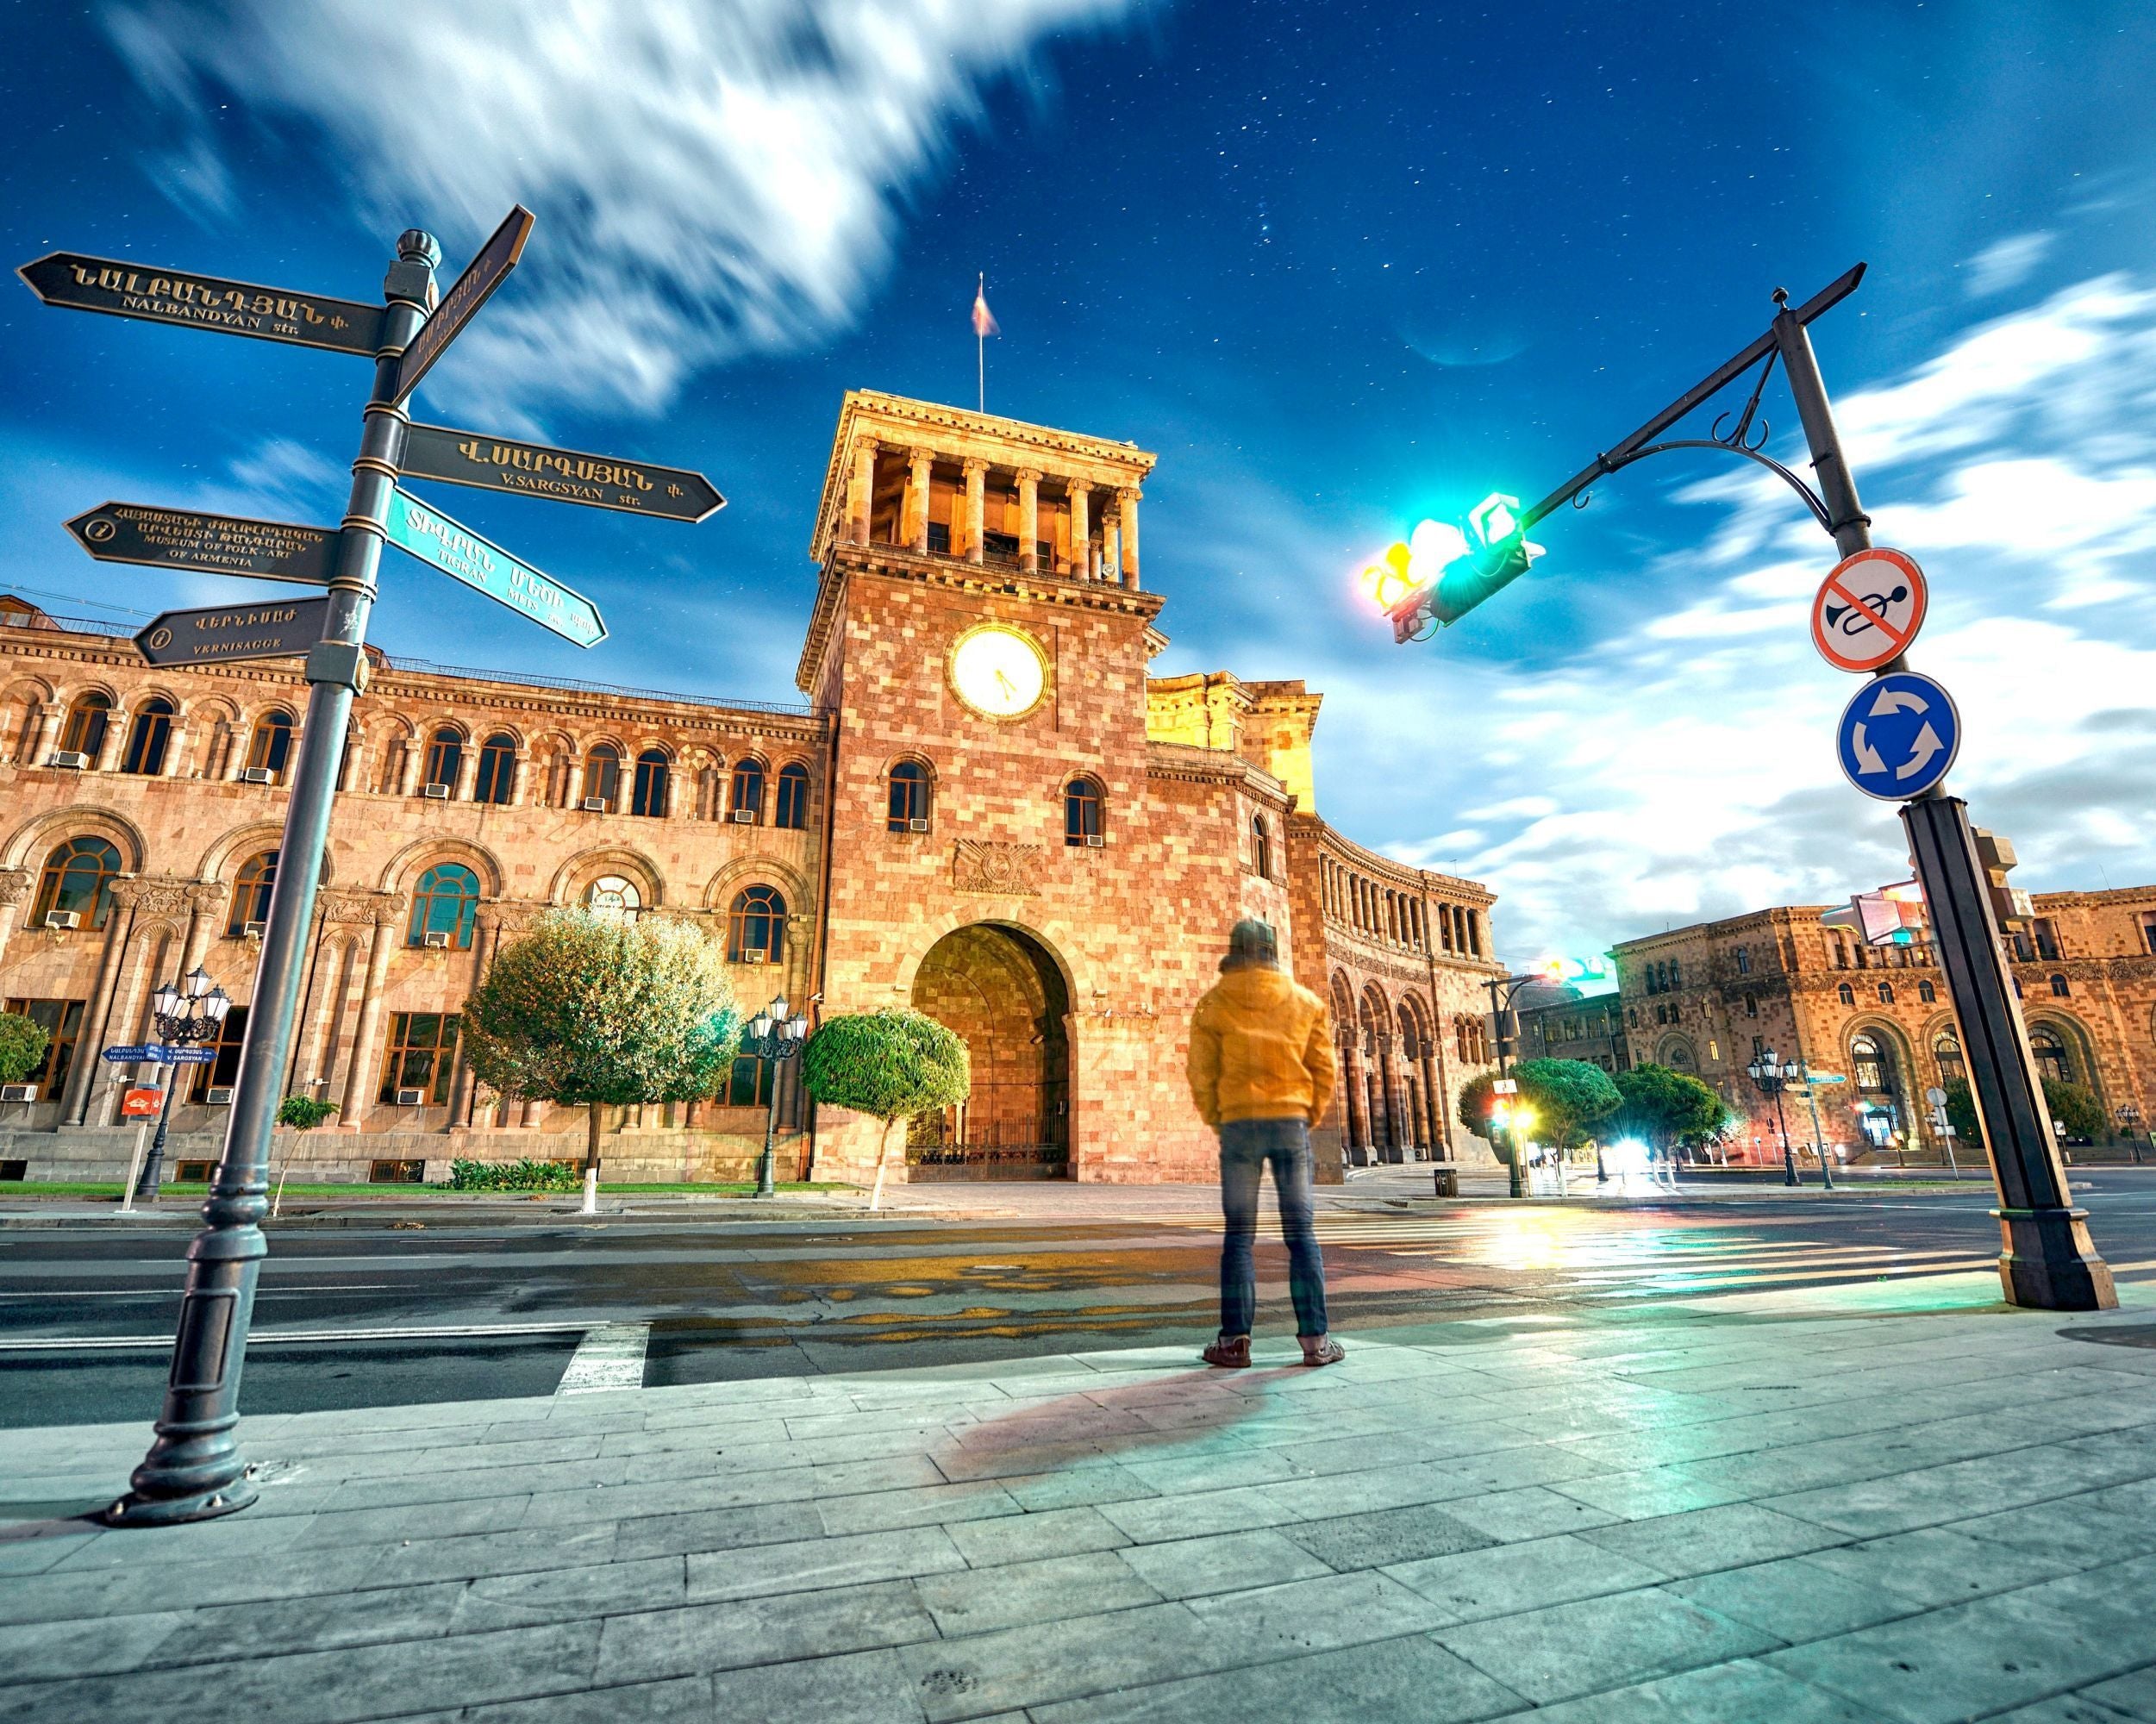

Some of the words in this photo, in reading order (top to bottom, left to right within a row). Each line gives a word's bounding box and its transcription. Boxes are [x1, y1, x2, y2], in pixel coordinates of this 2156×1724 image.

[70, 264, 325, 324] ՆԱԼԲԱՆԴՅԱՆ
[330, 315, 348, 329] փ.
[122, 296, 261, 328] NALBANDYAN
[272, 322, 298, 334] str.
[619, 495, 641, 506] str.
[667, 484, 684, 497] փ.
[115, 508, 201, 527] ՀԱՅԱՍՏԱՆԻ
[208, 520, 323, 542] ԺՈՂՈՎՐԴԱԿԱՆ
[138, 522, 213, 540] ԱՐՎԵՍՏԻ
[218, 533, 306, 552] ԹԱՆԳԱՐԱՆ
[144, 534, 200, 548] MUSEUM
[203, 541, 222, 552] OF
[406, 508, 496, 572] ՏԻԳՐԱՆ
[169, 549, 187, 559] OF
[191, 553, 253, 567] ARMENIA
[438, 548, 486, 584] TIGRAN
[507, 587, 539, 611] METS
[196, 609, 297, 630] ՎԵՐՆԻՍԱԺ
[193, 638, 282, 655] VERNISAGGE
